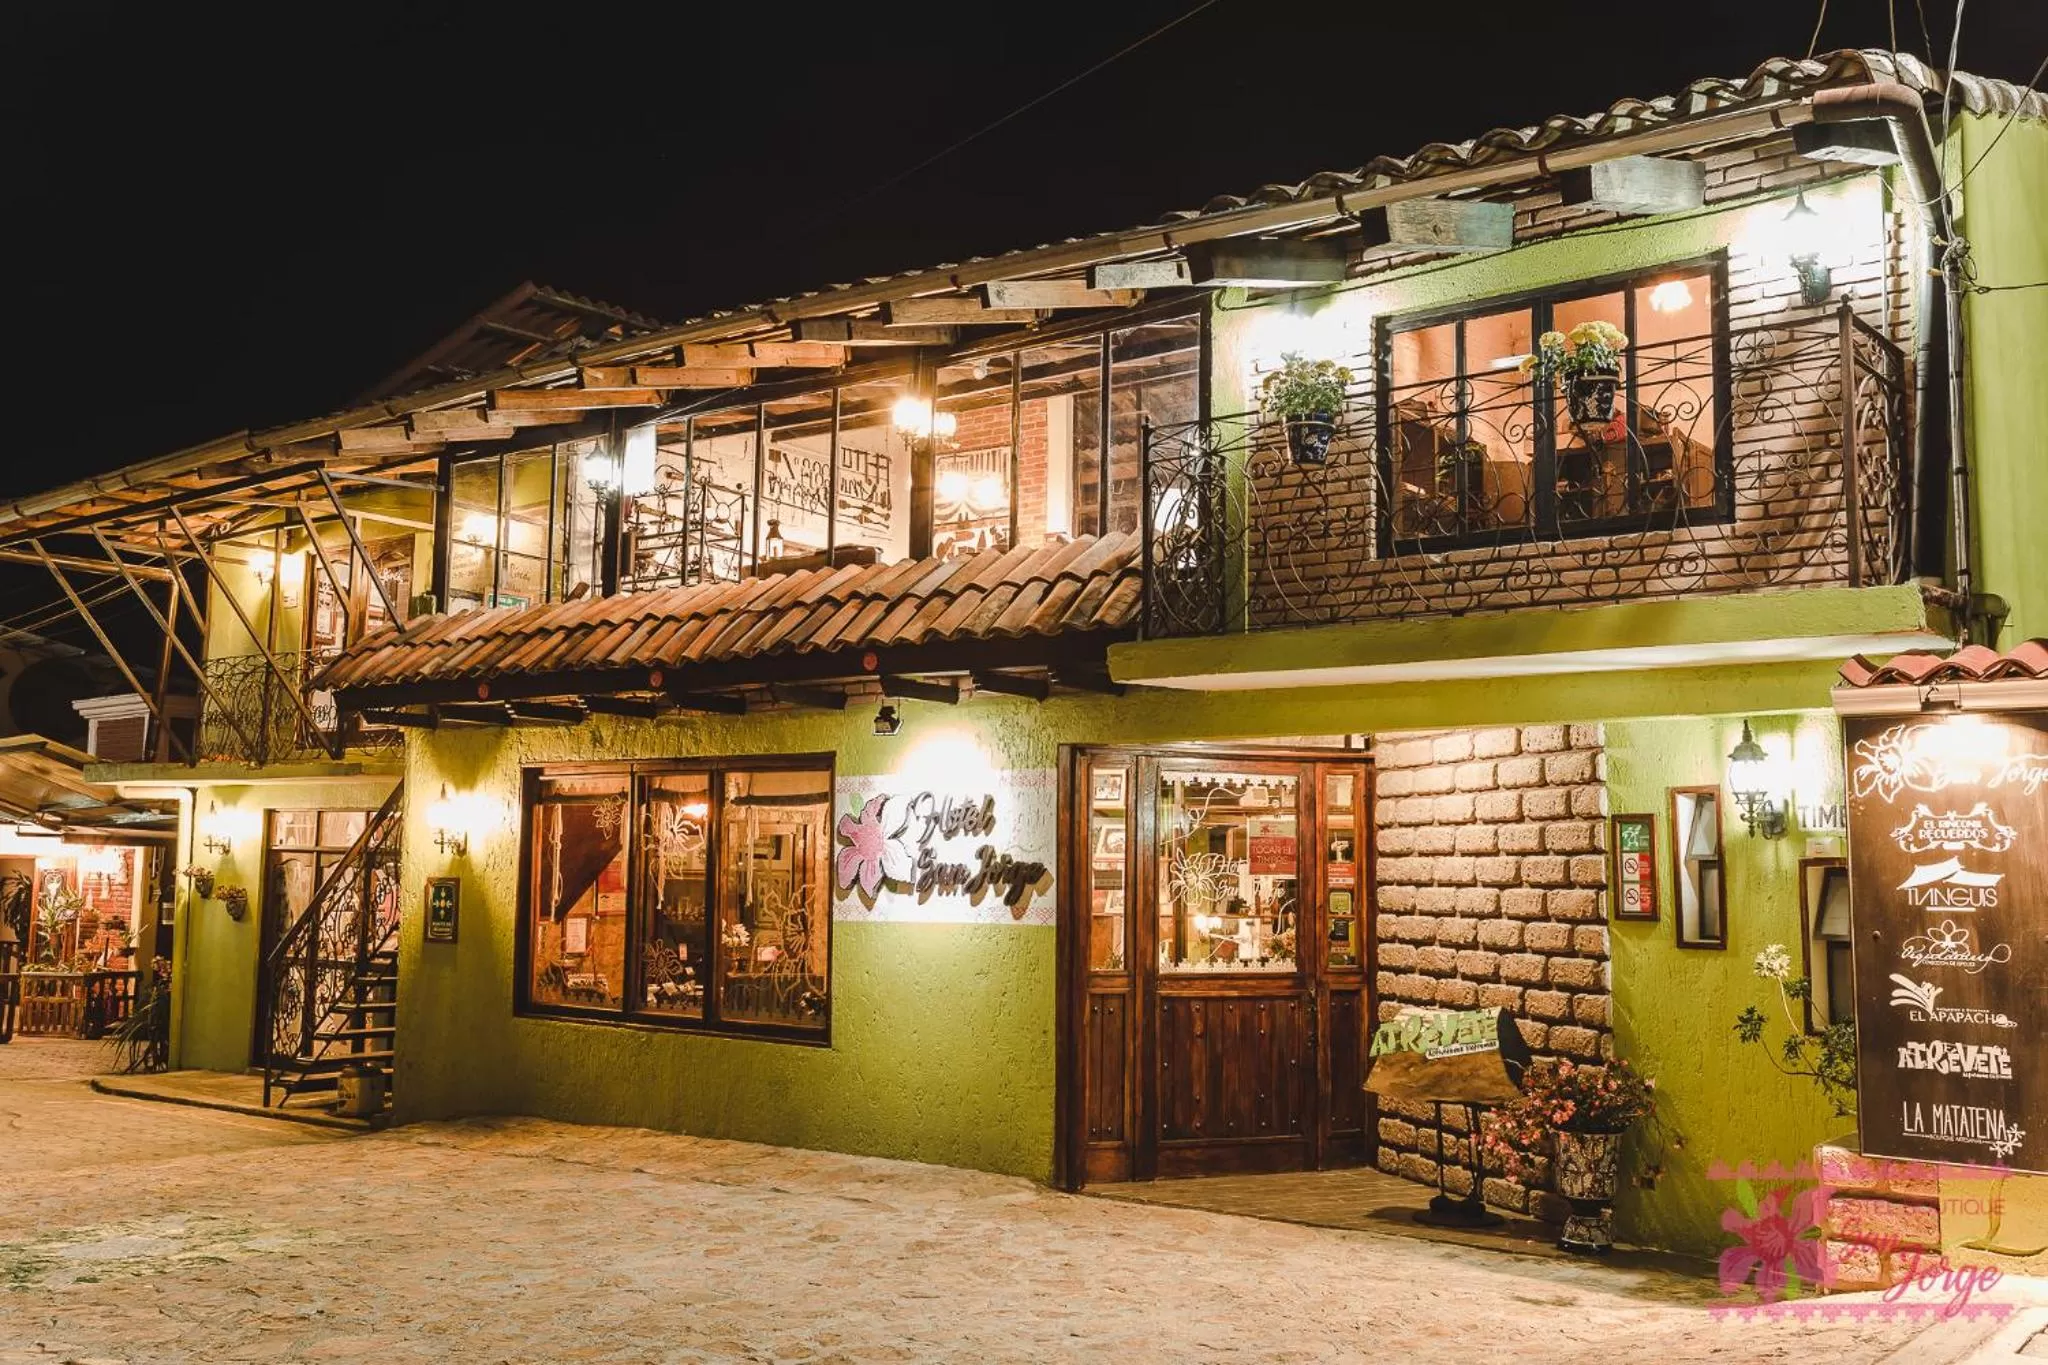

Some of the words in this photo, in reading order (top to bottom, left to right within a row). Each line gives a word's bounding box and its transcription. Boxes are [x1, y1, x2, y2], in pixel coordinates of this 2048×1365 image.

[916, 791, 996, 843] Hotel
[1919, 829, 1989, 840] RECUERDOS
[916, 848, 971, 894] San
[963, 845, 1048, 907] Jorge
[1907, 888, 1998, 908] TIANGUIS
[1909, 1010, 1926, 1022] EL
[1903, 1101, 1924, 1132] LA
[1932, 1103, 2008, 1141] MATATENA
